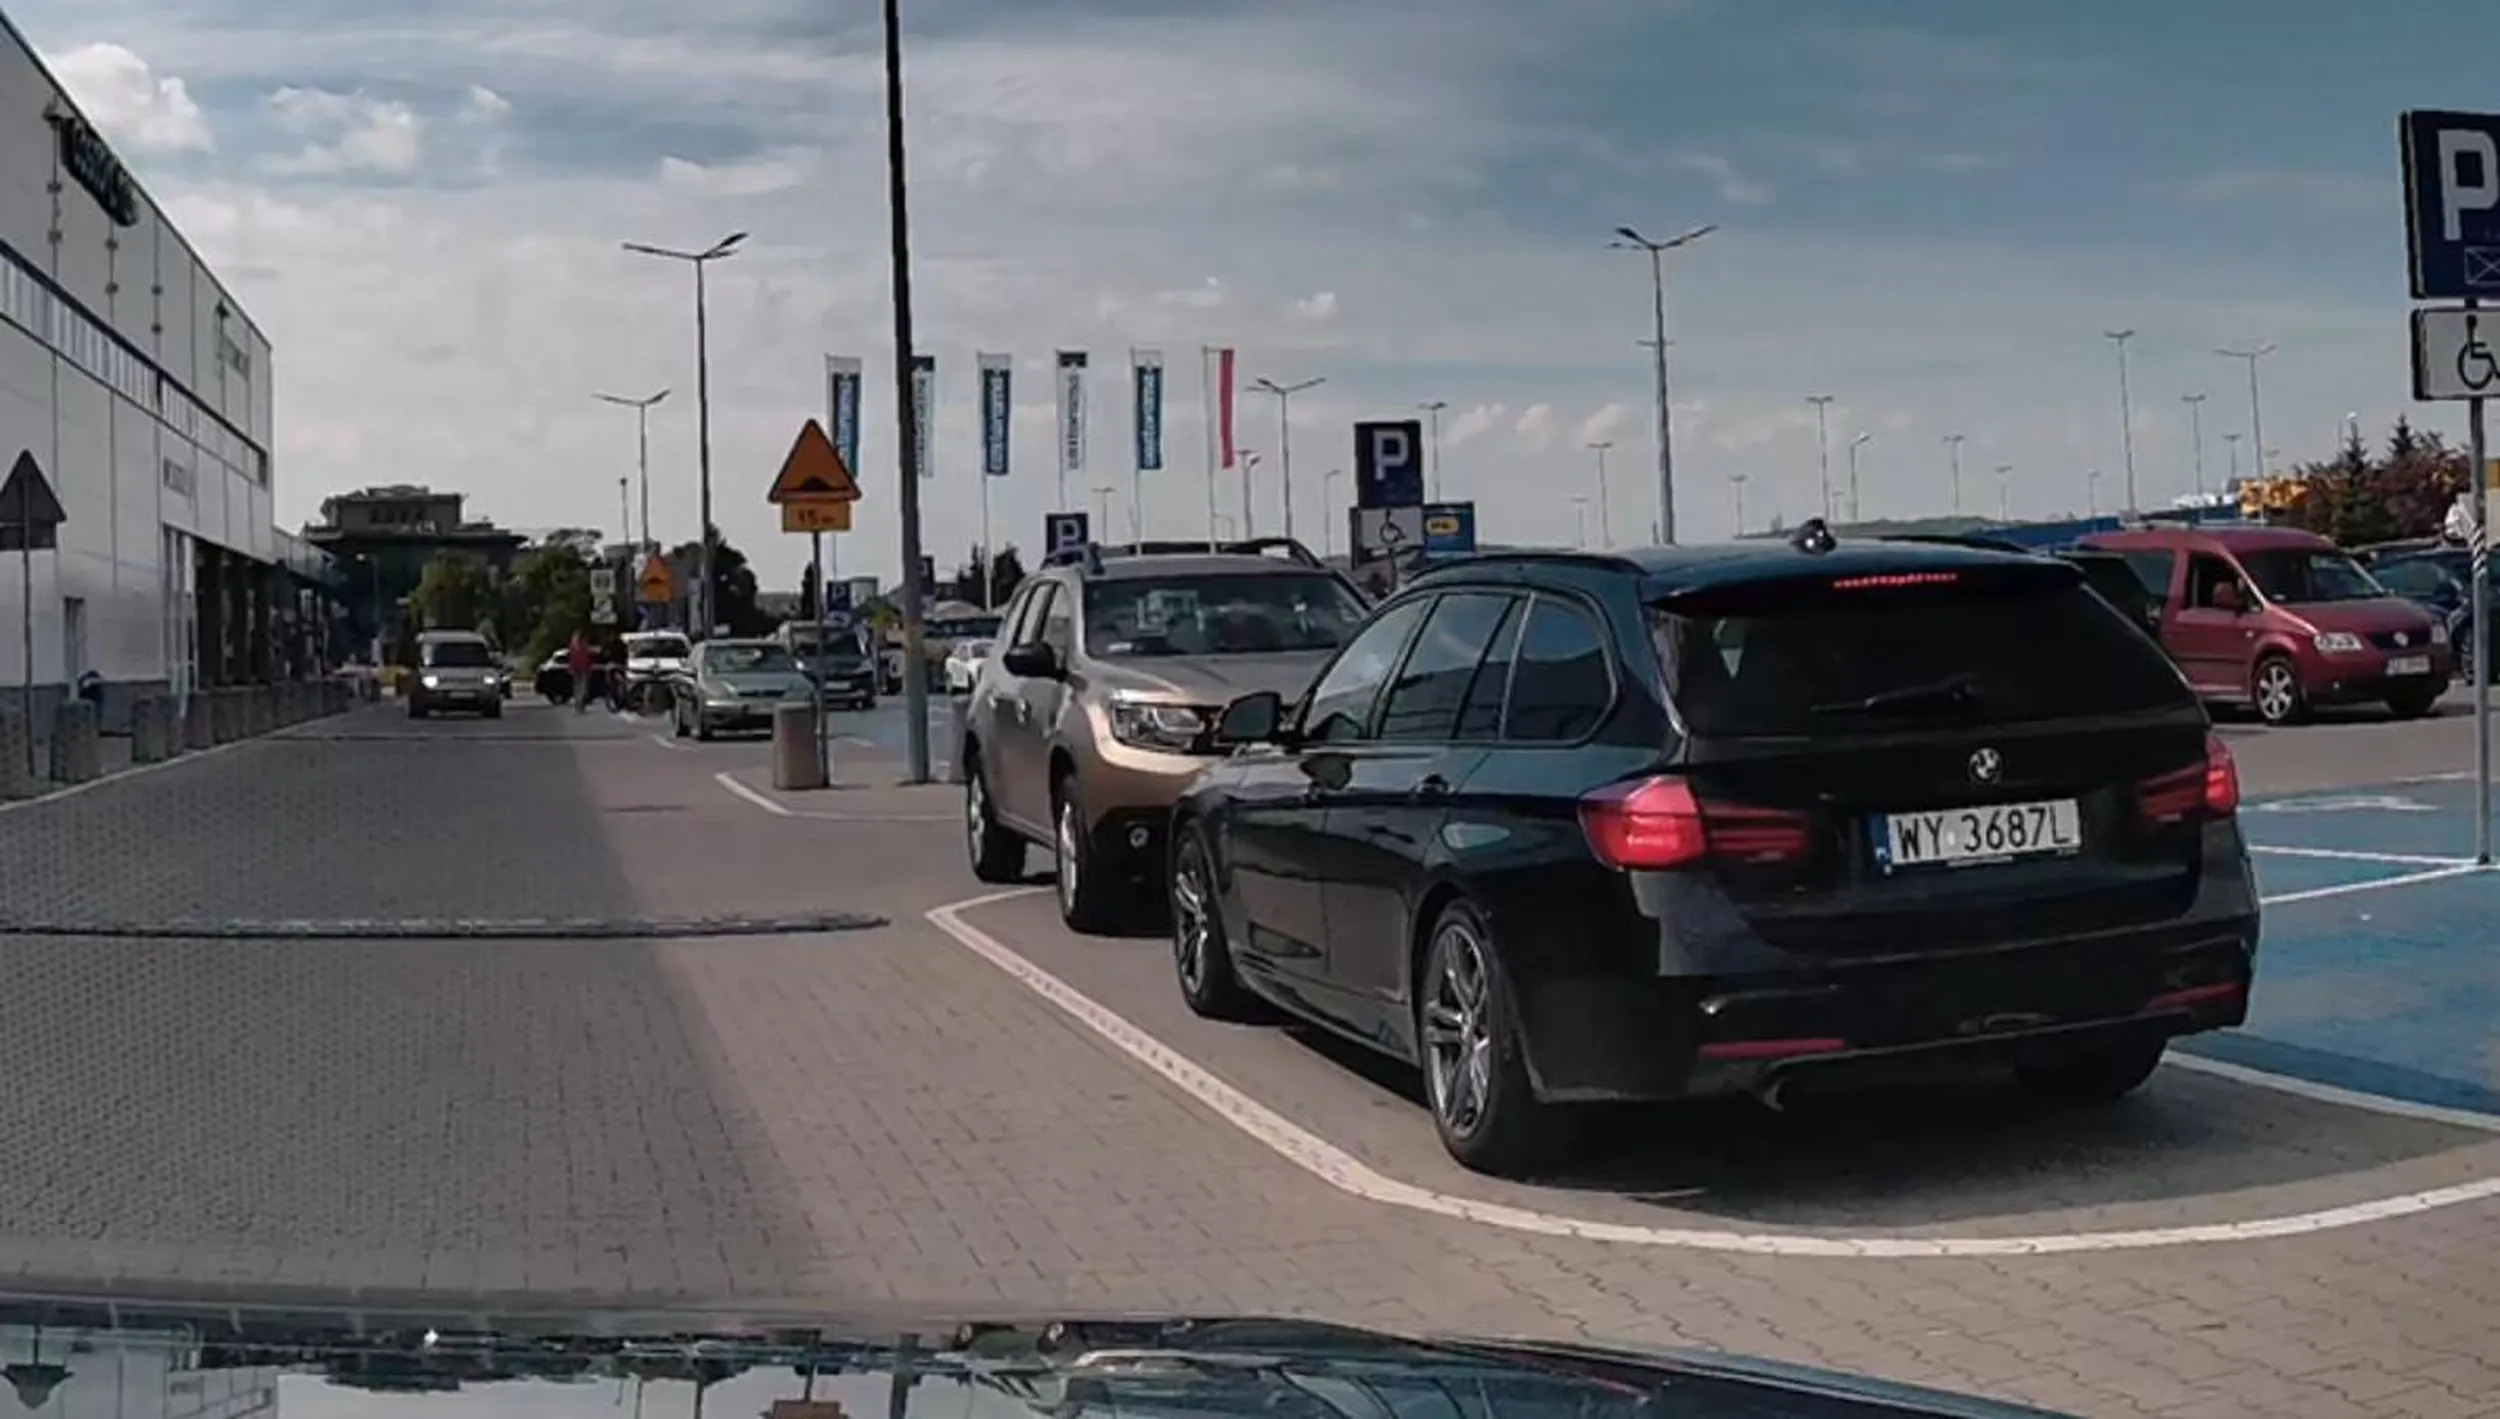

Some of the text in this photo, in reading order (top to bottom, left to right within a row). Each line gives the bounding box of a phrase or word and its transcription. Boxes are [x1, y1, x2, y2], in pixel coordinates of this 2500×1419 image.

[2438, 129, 2498, 241] P
[1373, 430, 1409, 480] P
[1056, 520, 1080, 552] P
[1897, 805, 2070, 859] WY 3687L
